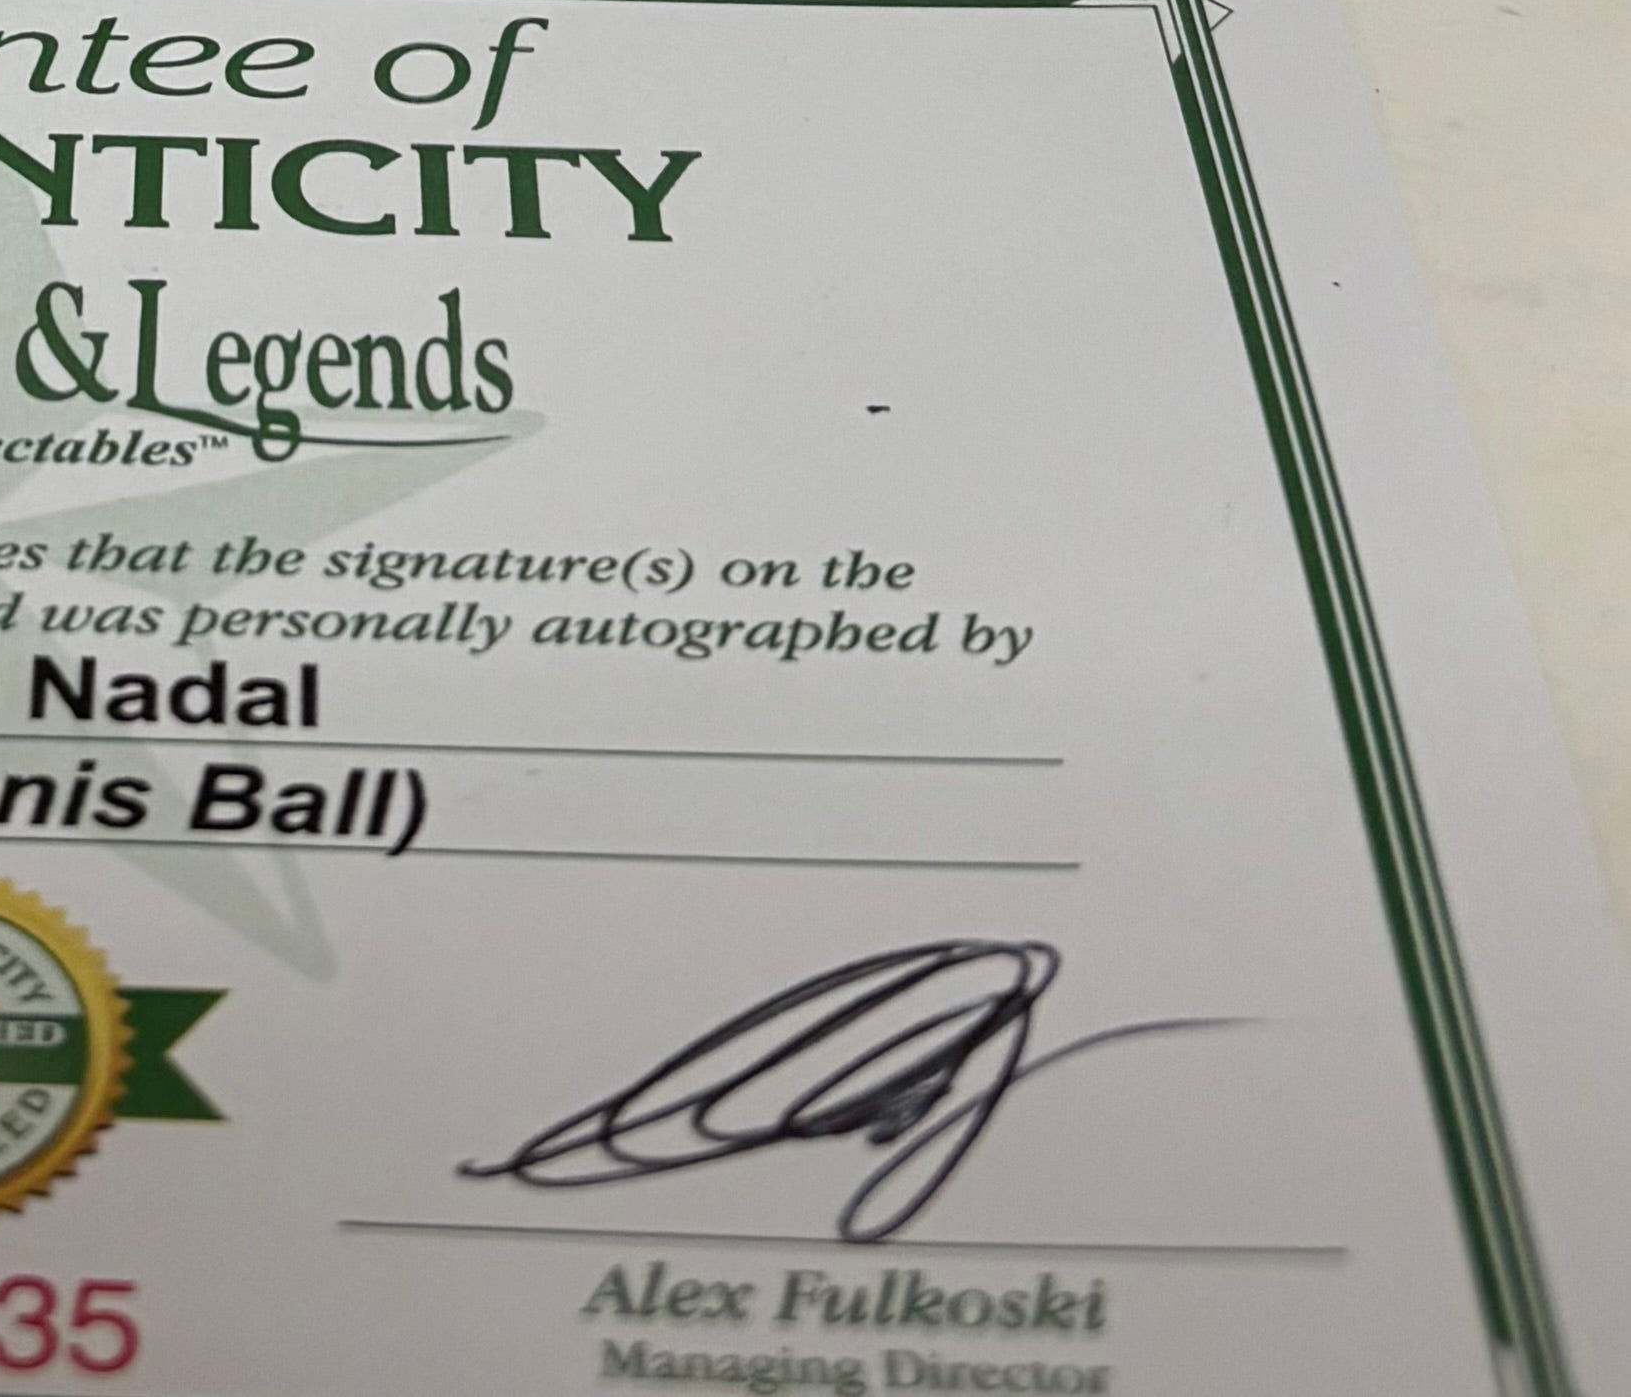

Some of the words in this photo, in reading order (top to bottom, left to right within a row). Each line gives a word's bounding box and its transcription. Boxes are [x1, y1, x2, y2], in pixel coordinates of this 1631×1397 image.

[370, 14, 550, 130] of
[13, 280, 119, 403] &
[128, 280, 516, 466] Legends
[64, 533, 194, 575] that
[212, 536, 306, 577] the
[322, 540, 698, 594] signature(s)
[718, 556, 804, 592] on
[819, 550, 916, 592] the
[41, 606, 166, 637] was
[174, 600, 514, 658] personally
[530, 608, 940, 666] autographed
[958, 616, 1034, 668] by
[30, 656, 322, 730] Nadal
[188, 762, 428, 856] Ball)
[580, 1258, 754, 1324] Alex
[773, 1267, 1108, 1332] Fulkoski
[599, 1337, 866, 1396] Managing
[882, 1346, 1112, 1396] Director
